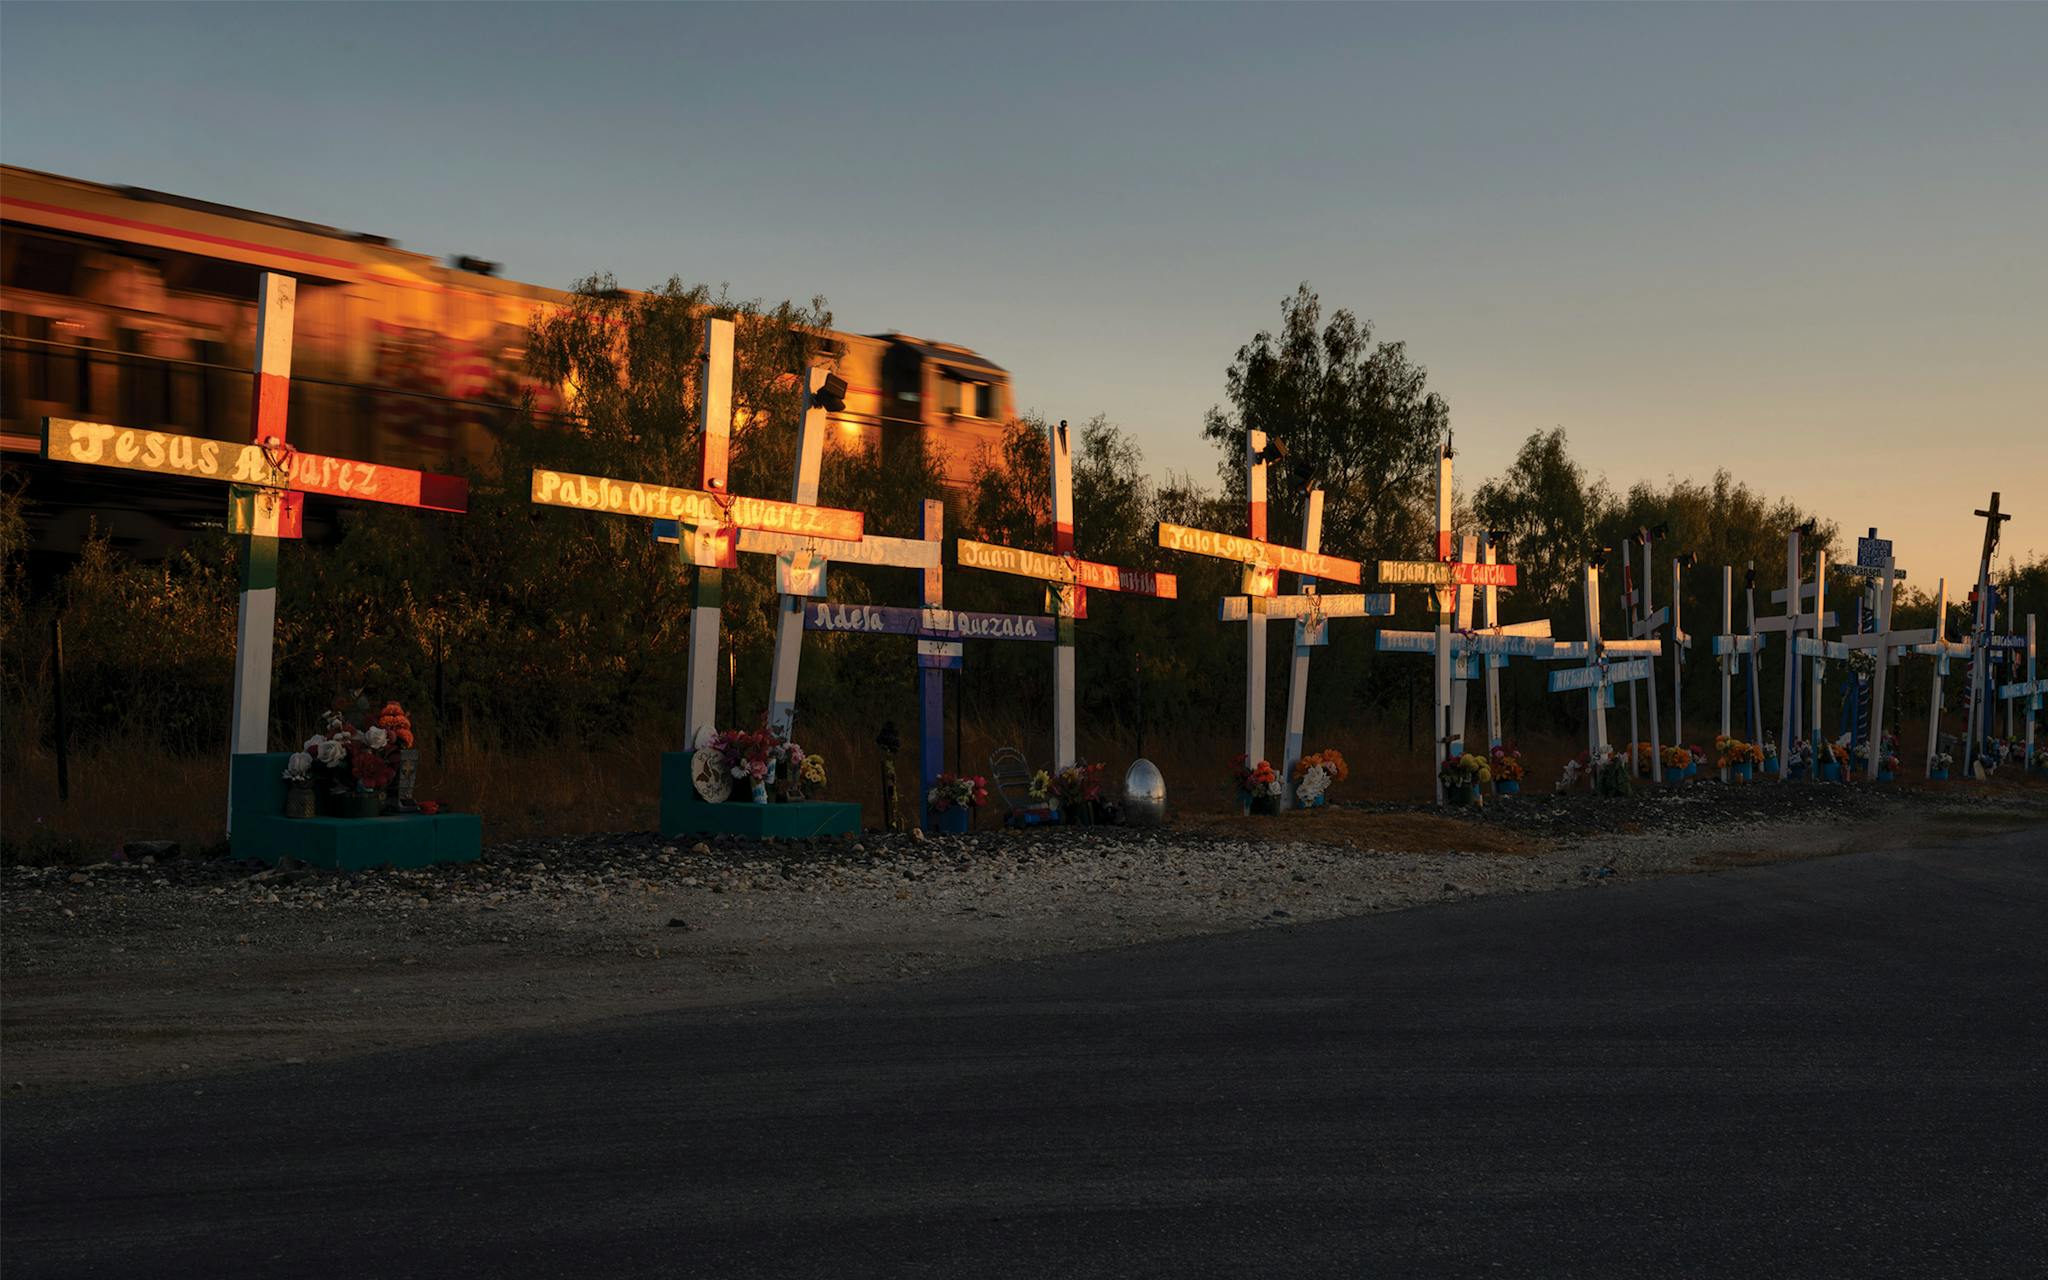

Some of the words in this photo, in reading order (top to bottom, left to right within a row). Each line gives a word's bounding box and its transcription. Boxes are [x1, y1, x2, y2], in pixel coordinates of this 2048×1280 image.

[68, 421, 220, 475] Jesus
[232, 445, 379, 495] Avarez
[537, 470, 623, 511] Pablo
[964, 541, 1016, 568] Juan
[1279, 546, 1331, 573] Lopez
[814, 602, 885, 631] Adela
[957, 611, 1038, 637] Quezada
